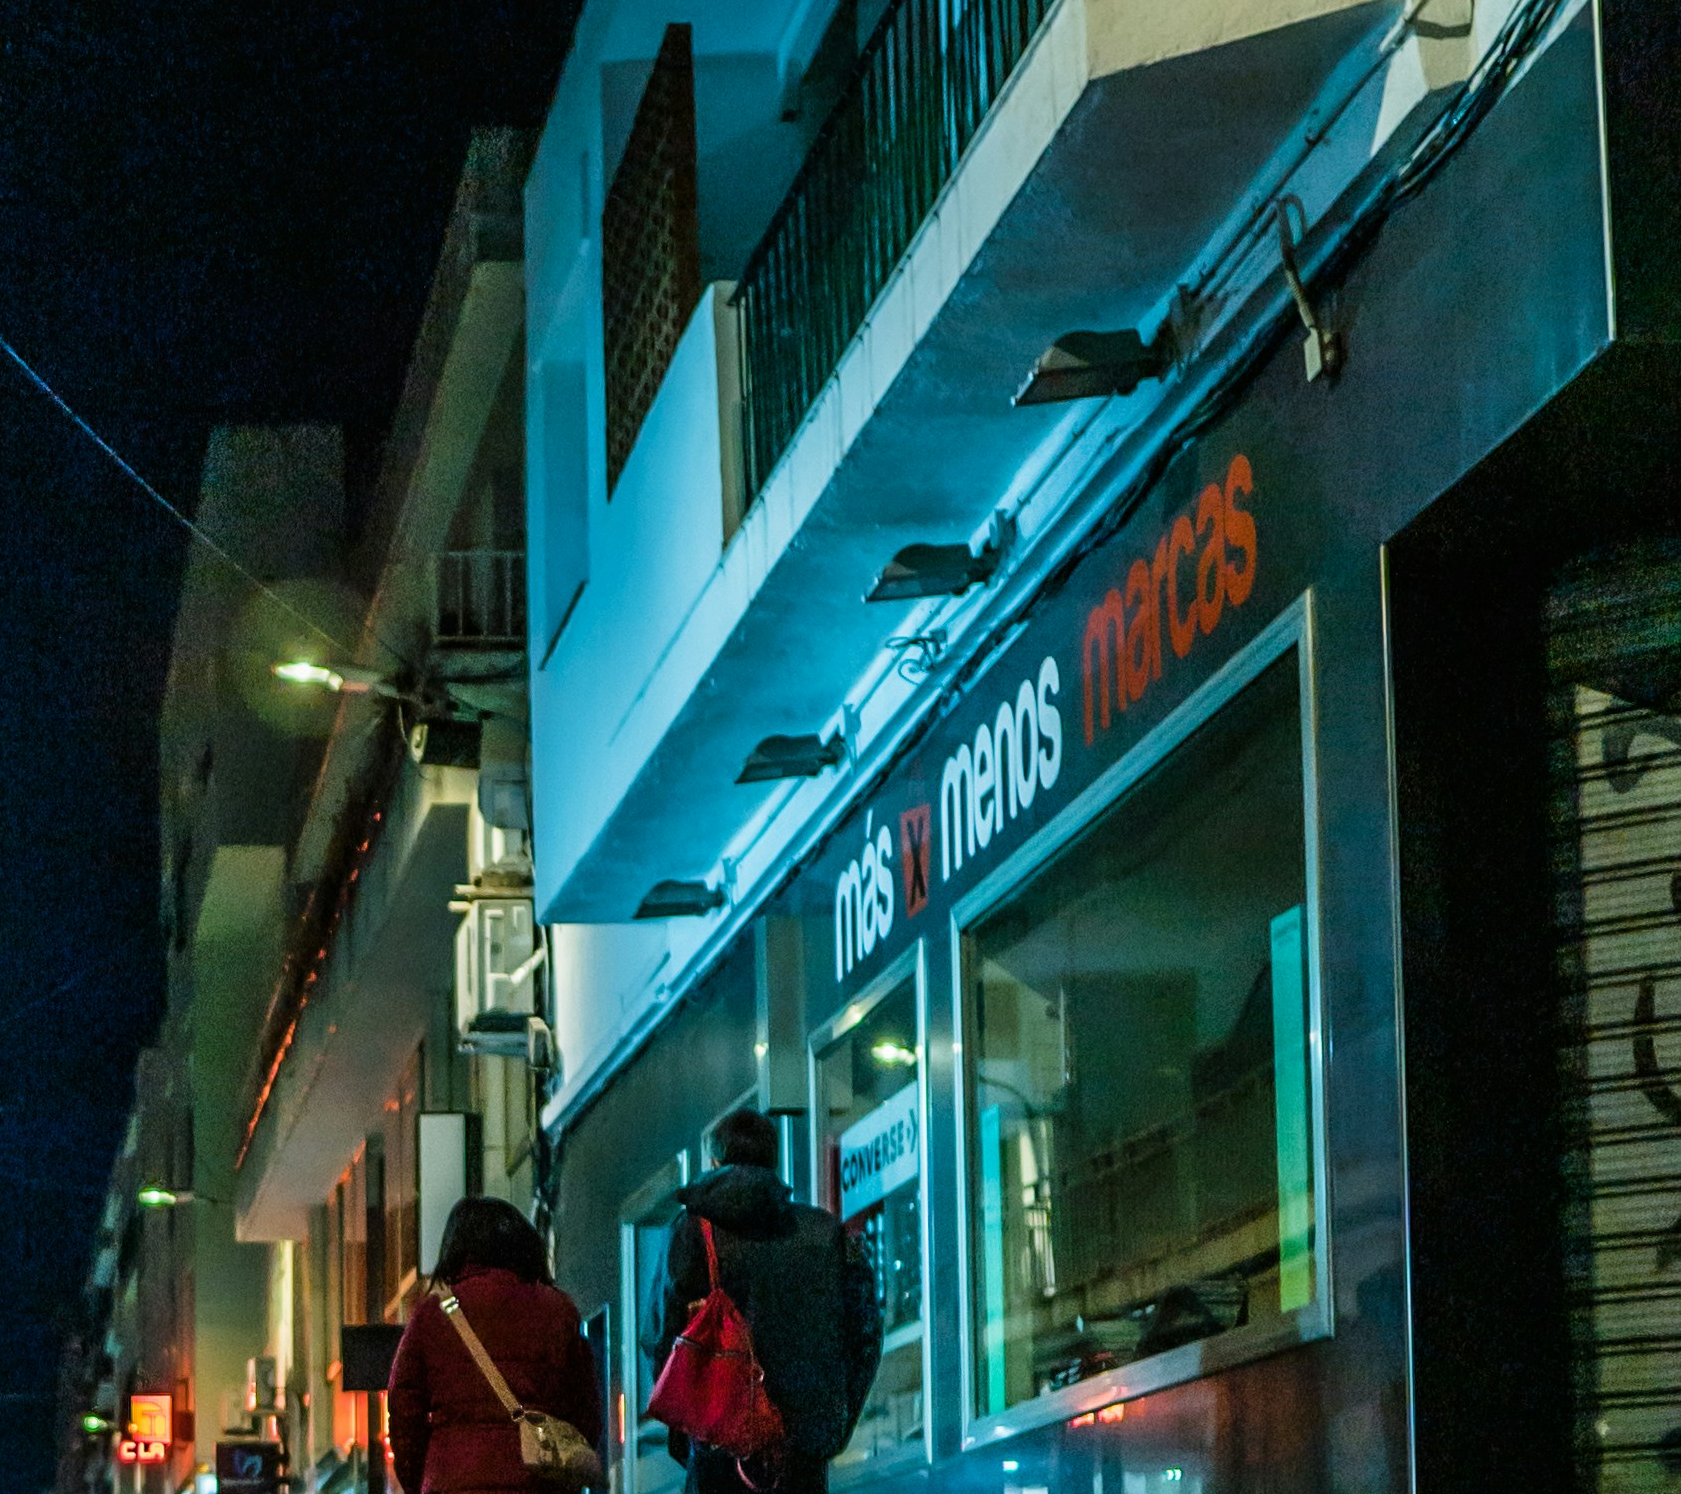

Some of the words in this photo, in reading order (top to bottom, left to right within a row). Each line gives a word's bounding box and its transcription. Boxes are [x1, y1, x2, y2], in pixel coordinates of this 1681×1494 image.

[835, 809, 894, 982] más
[940, 655, 1062, 882] menos
[1083, 454, 1257, 747] marcas
[842, 1120, 904, 1193] CONVERSE
